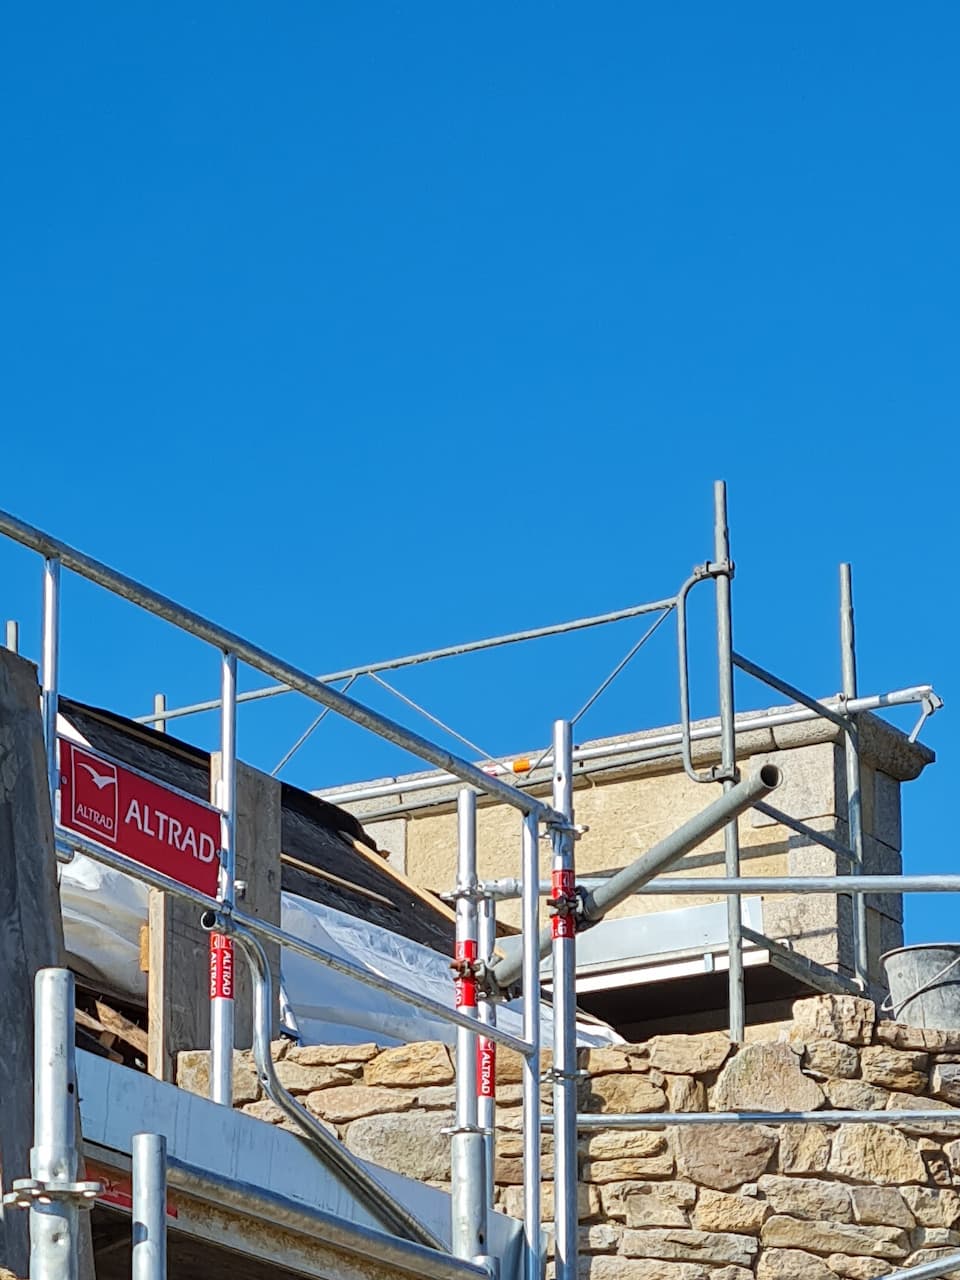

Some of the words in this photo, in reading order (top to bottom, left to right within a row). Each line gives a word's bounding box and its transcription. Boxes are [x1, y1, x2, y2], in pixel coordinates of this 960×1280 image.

[76, 803, 114, 831] ALTRAD
[124, 799, 216, 864] ALTRAD
[222, 949, 232, 996] ALTRAD
[481, 1051, 491, 1094] ALTRAD
